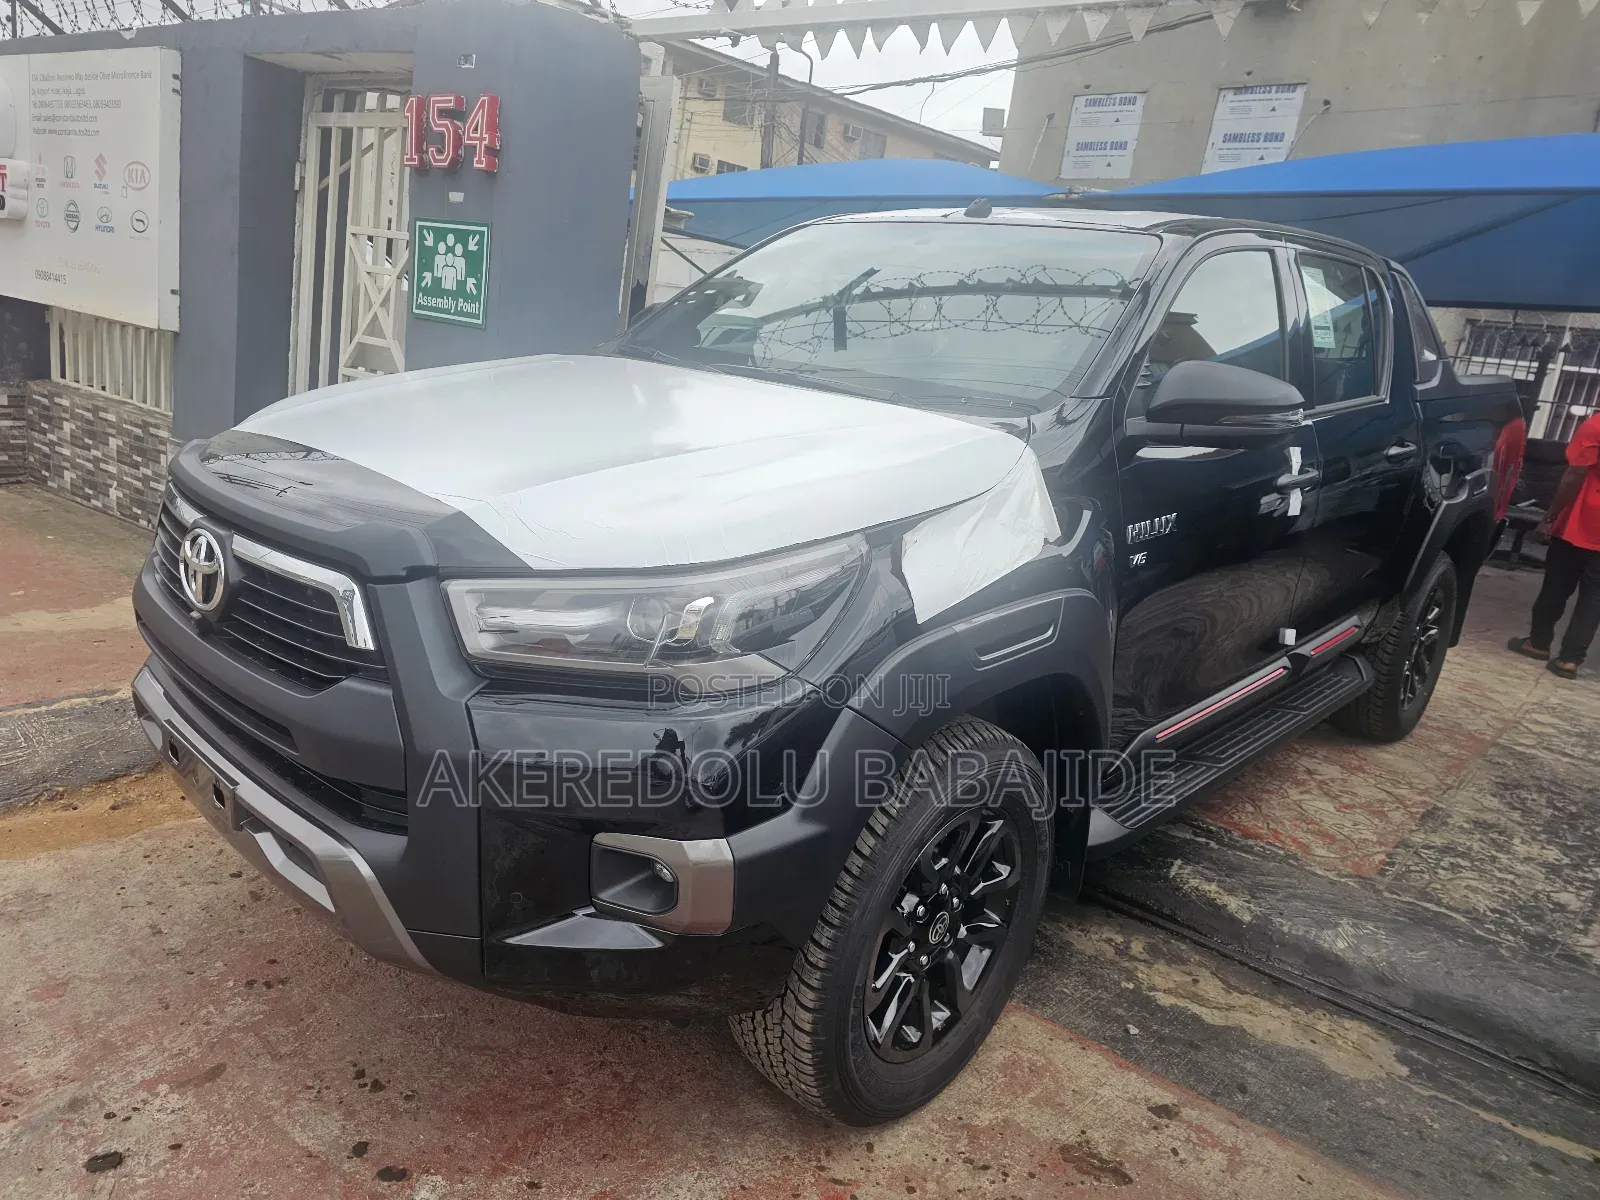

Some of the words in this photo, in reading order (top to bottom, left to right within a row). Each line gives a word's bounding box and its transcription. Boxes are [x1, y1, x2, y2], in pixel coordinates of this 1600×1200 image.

[74, 72, 83, 83] Way
[84, 71, 99, 81] beside
[99, 71, 111, 80] Olive
[111, 70, 140, 80] Microfinance
[140, 69, 153, 80] Bank
[1084, 97, 1118, 108] SAMBLESS
[1118, 95, 1137, 107] BOND
[403, 93, 501, 172] 154
[1221, 132, 1262, 144] SAMBLESS
[1263, 131, 1286, 143] BOND
[1075, 141, 1108, 152] SAMBLESS
[1109, 140, 1129, 151] BOND
[128, 167, 147, 185] KIA
[93, 182, 109, 190] SUZUKI
[65, 212, 80, 220] NISSAN
[34, 219, 51, 229] TOYOTA
[94, 224, 115, 234] HYUNDAI
[417, 291, 457, 314] Assembly
[457, 298, 480, 315] Point
[1126, 512, 1178, 545] HILUX
